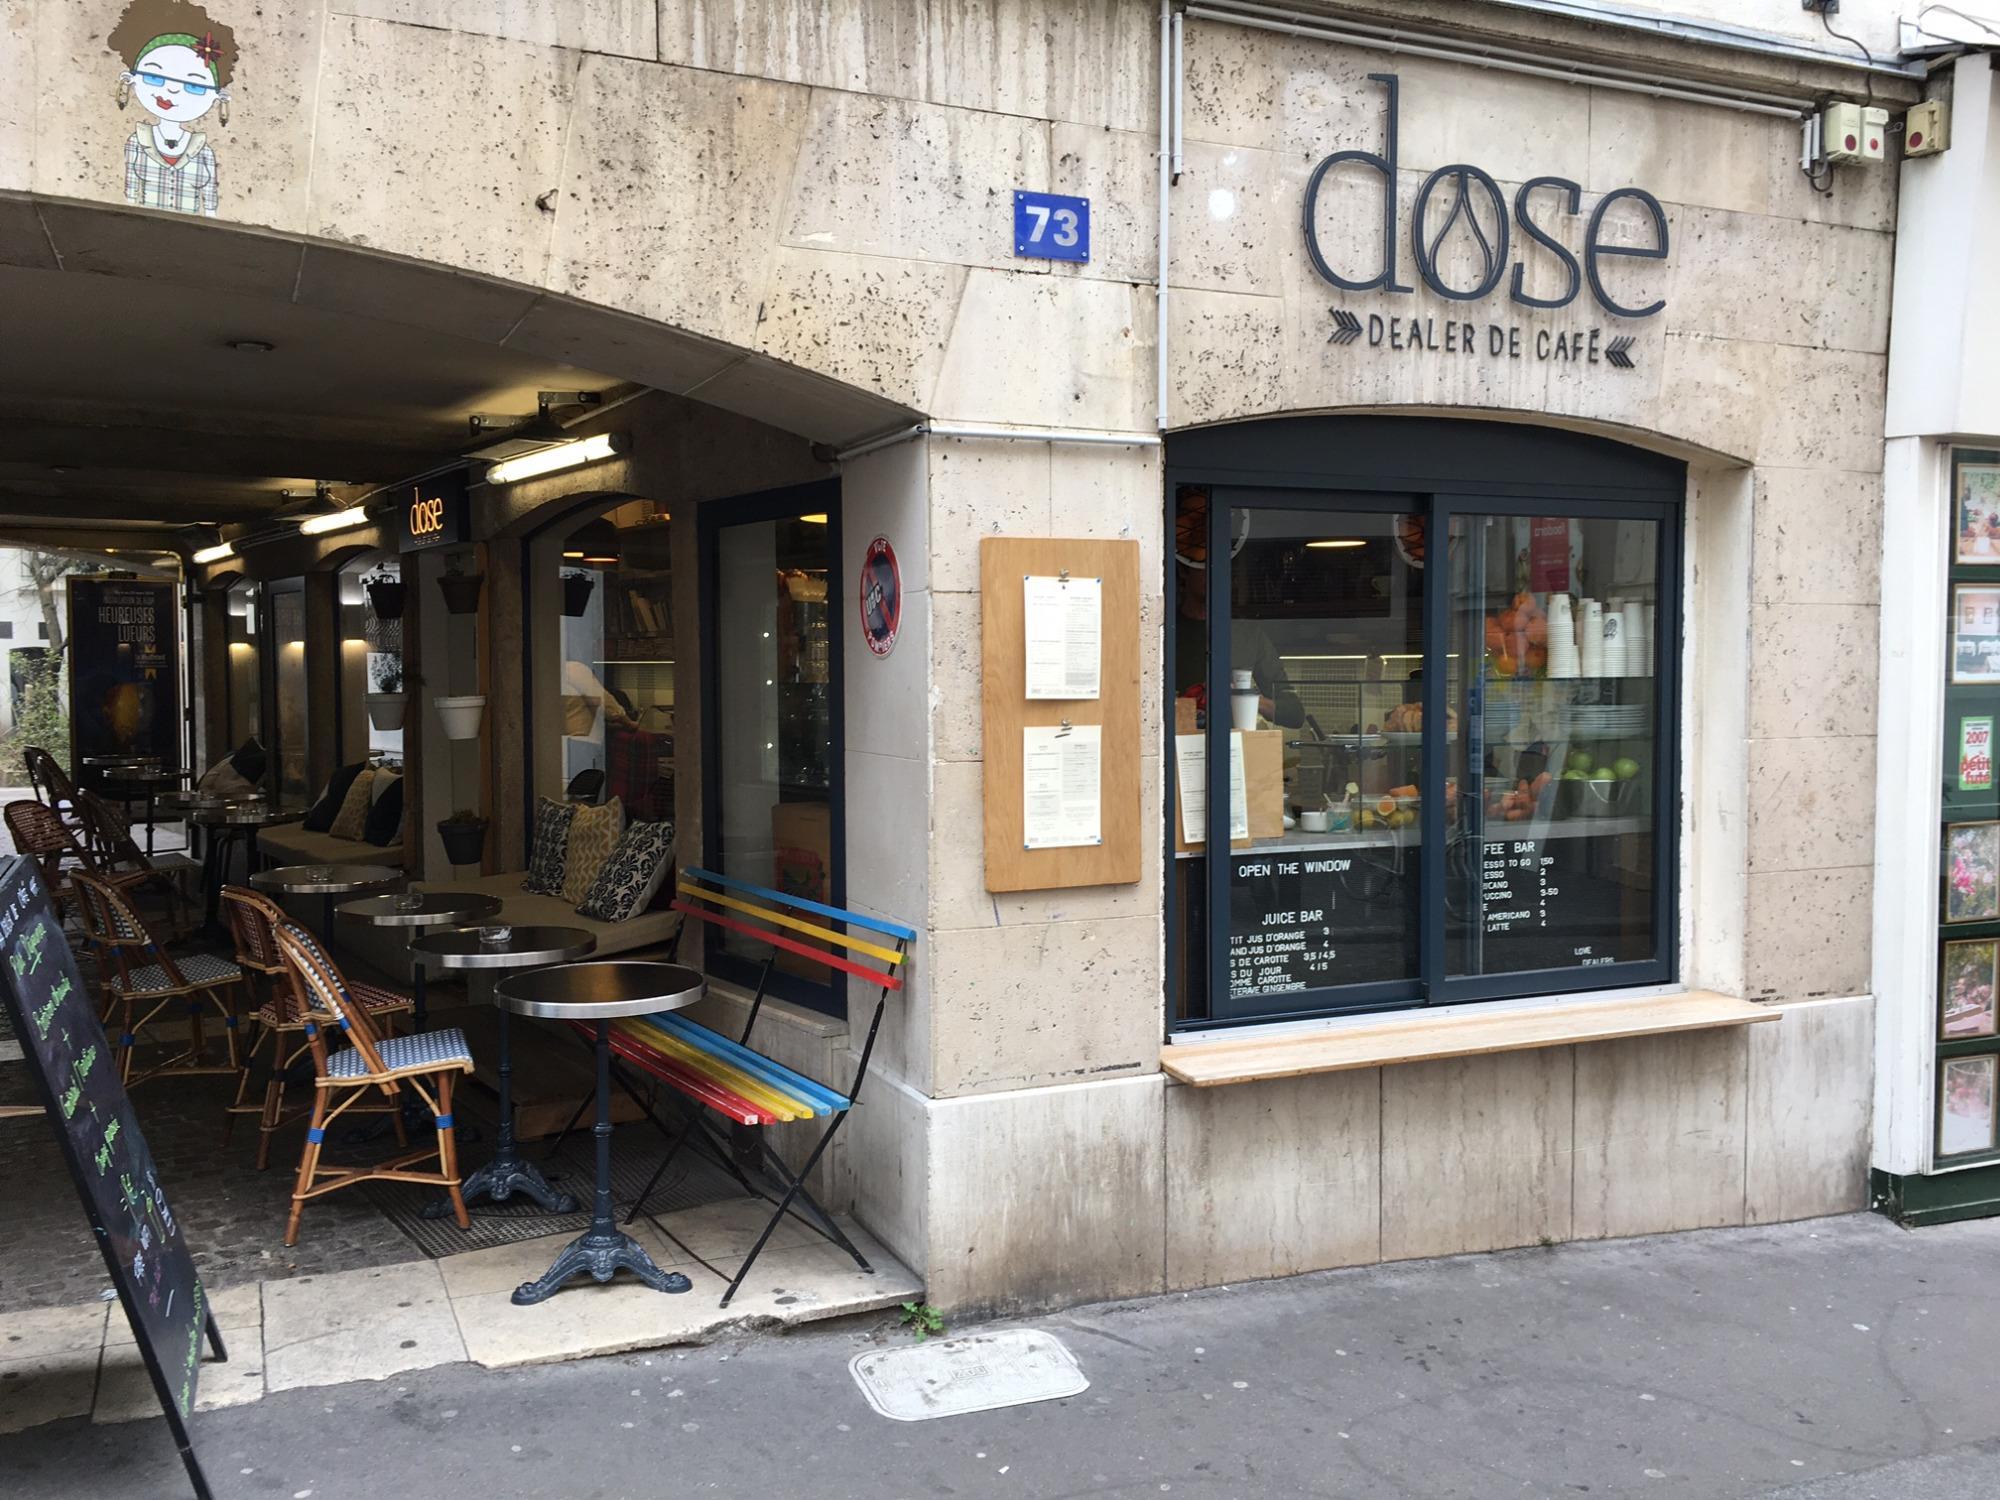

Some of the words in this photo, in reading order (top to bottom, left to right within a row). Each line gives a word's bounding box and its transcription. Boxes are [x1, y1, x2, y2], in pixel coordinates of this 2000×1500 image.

[1303, 73, 1669, 318] dose
[1026, 205, 1079, 247] 73
[1369, 314, 1475, 354] DEALER
[1489, 324, 1520, 358] DE
[1536, 328, 1600, 364] CAFÉ
[410, 487, 443, 535] dose
[98, 606, 155, 624] HEUREUSES
[118, 625, 156, 642] LUEURS
[1966, 731, 1989, 744] 2007
[1484, 843, 1505, 855] FEE
[1514, 841, 1535, 853] BAR
[1239, 865, 1271, 877] OPEN
[1278, 863, 1299, 875] THE
[1305, 860, 1351, 873] WINDOW
[1484, 860, 1505, 869] ESSO
[1508, 859, 1518, 867] TO
[1520, 858, 1531, 866] GO
[1484, 871, 1505, 879] ESSO
[1540, 868, 1546, 876] 2
[1540, 878, 1546, 886] 3
[1262, 912, 1296, 925] JUICE
[1300, 910, 1323, 922] BAR
[1487, 911, 1530, 921] AMERICANO
[1540, 910, 1546, 918] 3
[1488, 923, 1510, 932] LATTE
[1246, 935, 1263, 943] JUS
[1266, 931, 1306, 942] D'ORANGE
[1323, 926, 1330, 936] 3
[1248, 945, 1264, 954] JUS
[1323, 940, 1329, 948] 4
[1574, 946, 1592, 955] LOVE
[1238, 957, 1251, 967] DE
[1253, 955, 1289, 965] CAROTTE
[1240, 969, 1253, 978] DU
[1259, 966, 1282, 976] JOUR
[1257, 974, 1292, 985] CAROTTE
[1262, 981, 1306, 993] GINGEMBRE
